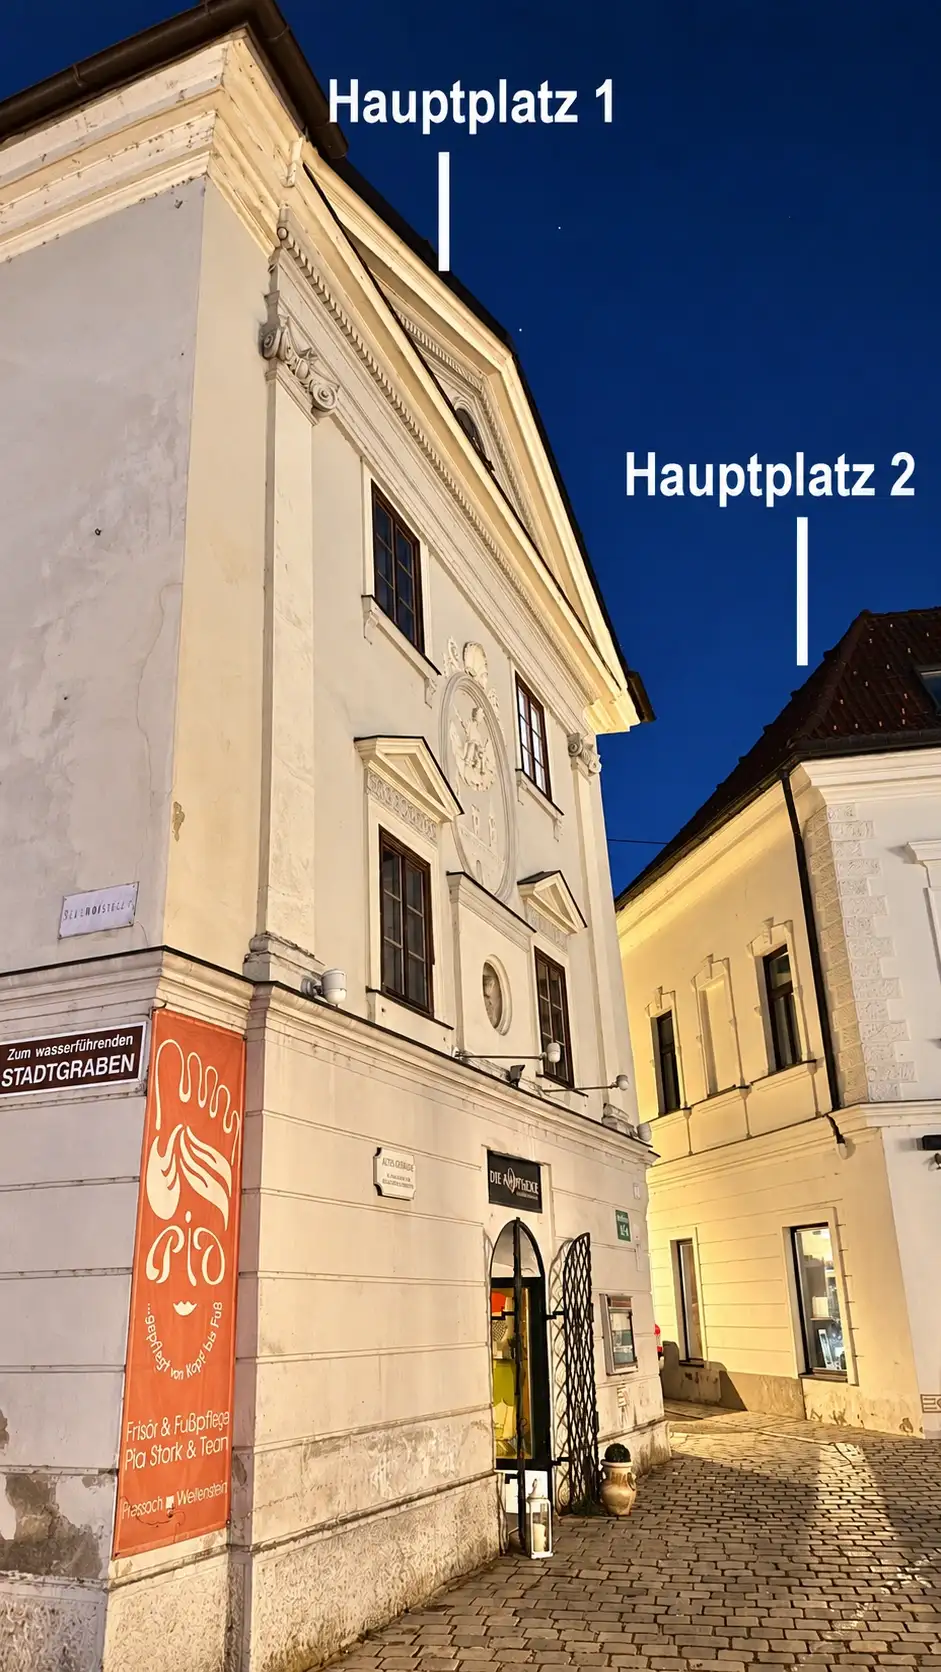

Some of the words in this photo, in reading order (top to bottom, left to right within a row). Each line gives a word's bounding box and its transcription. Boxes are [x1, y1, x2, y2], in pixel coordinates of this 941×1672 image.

[7, 1048, 31, 1061] Zum
[35, 1033, 133, 1058] wasserführenden
[1, 1053, 135, 1087] STADTGRABEN
[490, 1170, 502, 1185] DIE
[126, 1419, 158, 1442] Frisör
[160, 1417, 171, 1437] &
[125, 1448, 146, 1471] Pia
[149, 1441, 183, 1467] Stork
[186, 1440, 197, 1459] &
